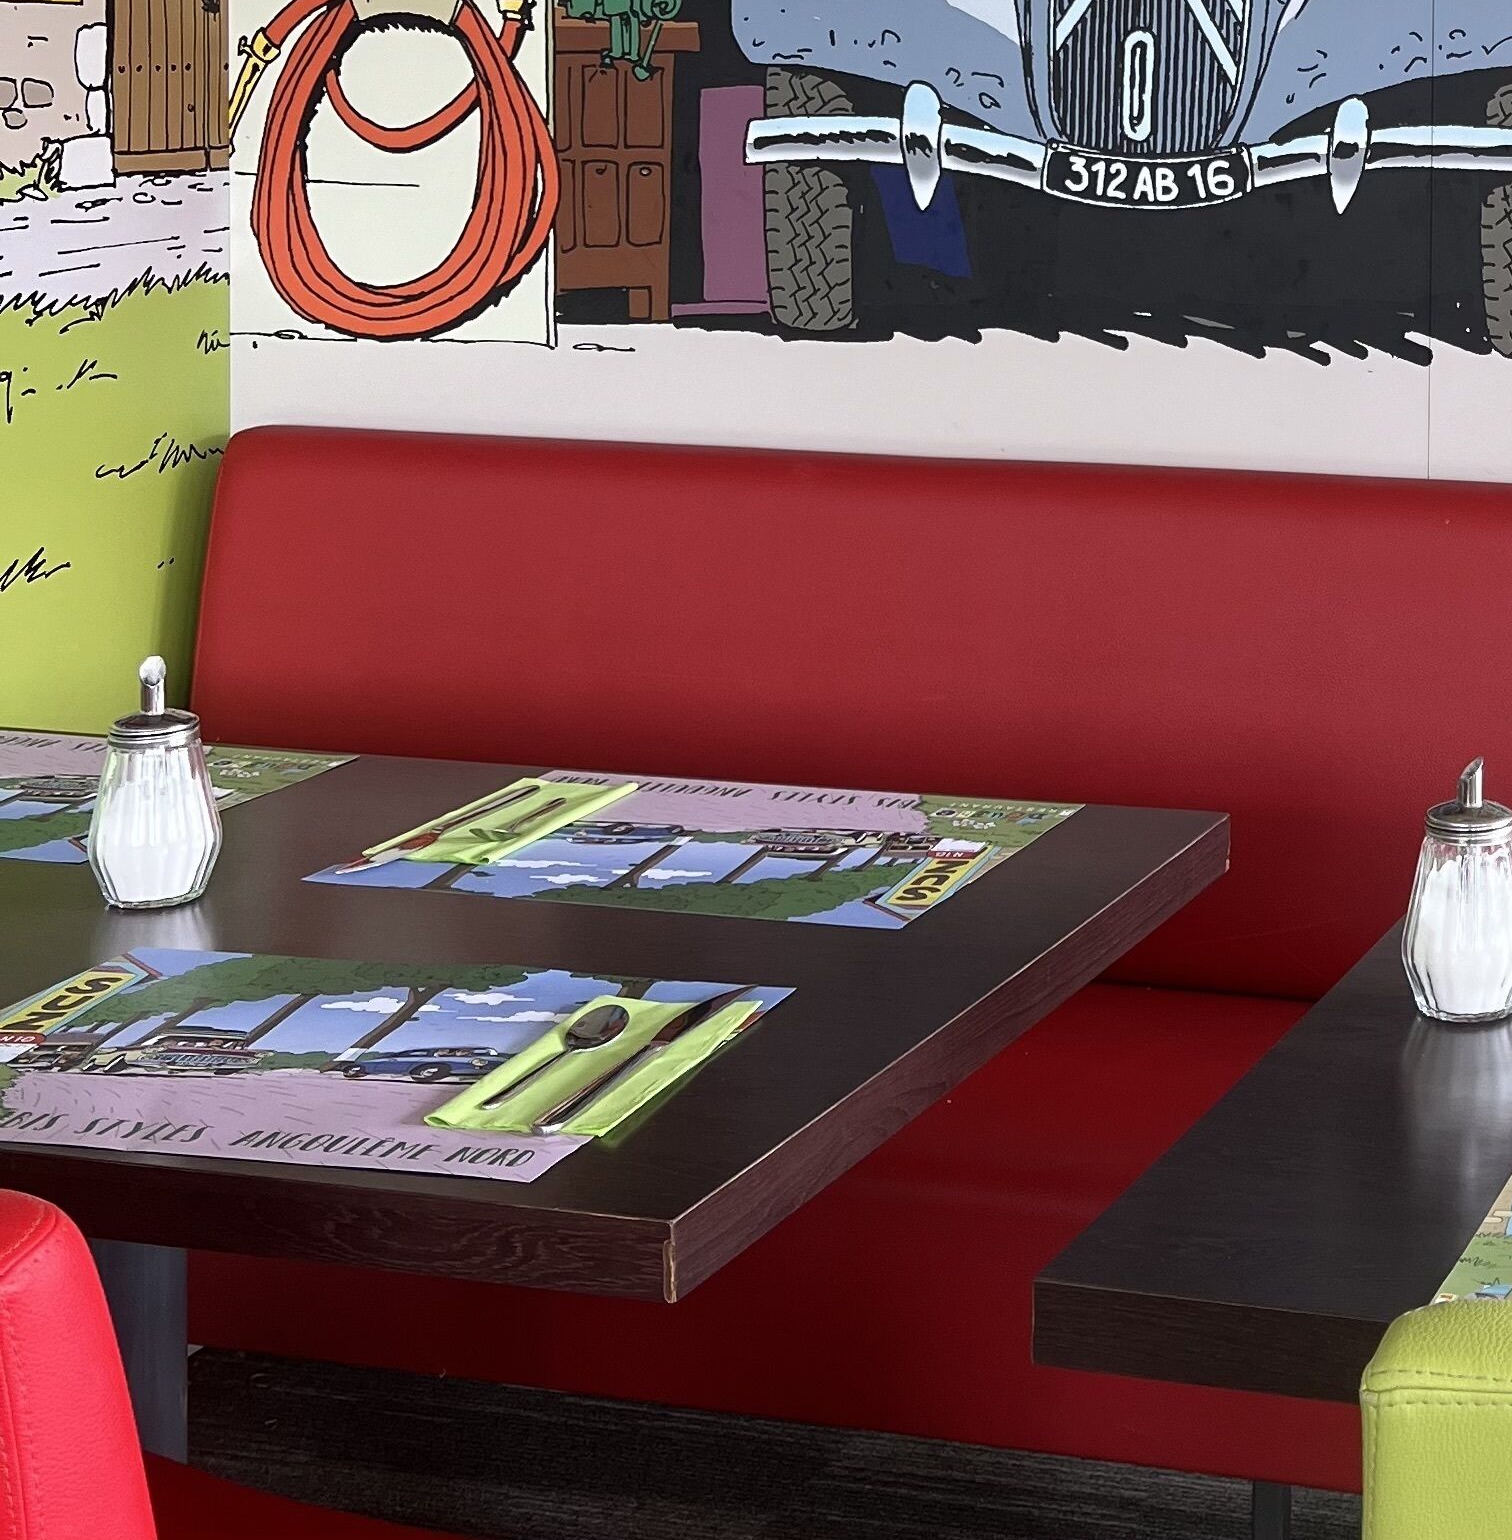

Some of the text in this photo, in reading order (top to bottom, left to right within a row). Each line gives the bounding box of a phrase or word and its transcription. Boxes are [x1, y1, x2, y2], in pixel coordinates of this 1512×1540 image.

[1064, 155, 1235, 203] 312 AB 16
[73, 1116, 215, 1143] STYLES
[442, 1145, 536, 1168] NORD
